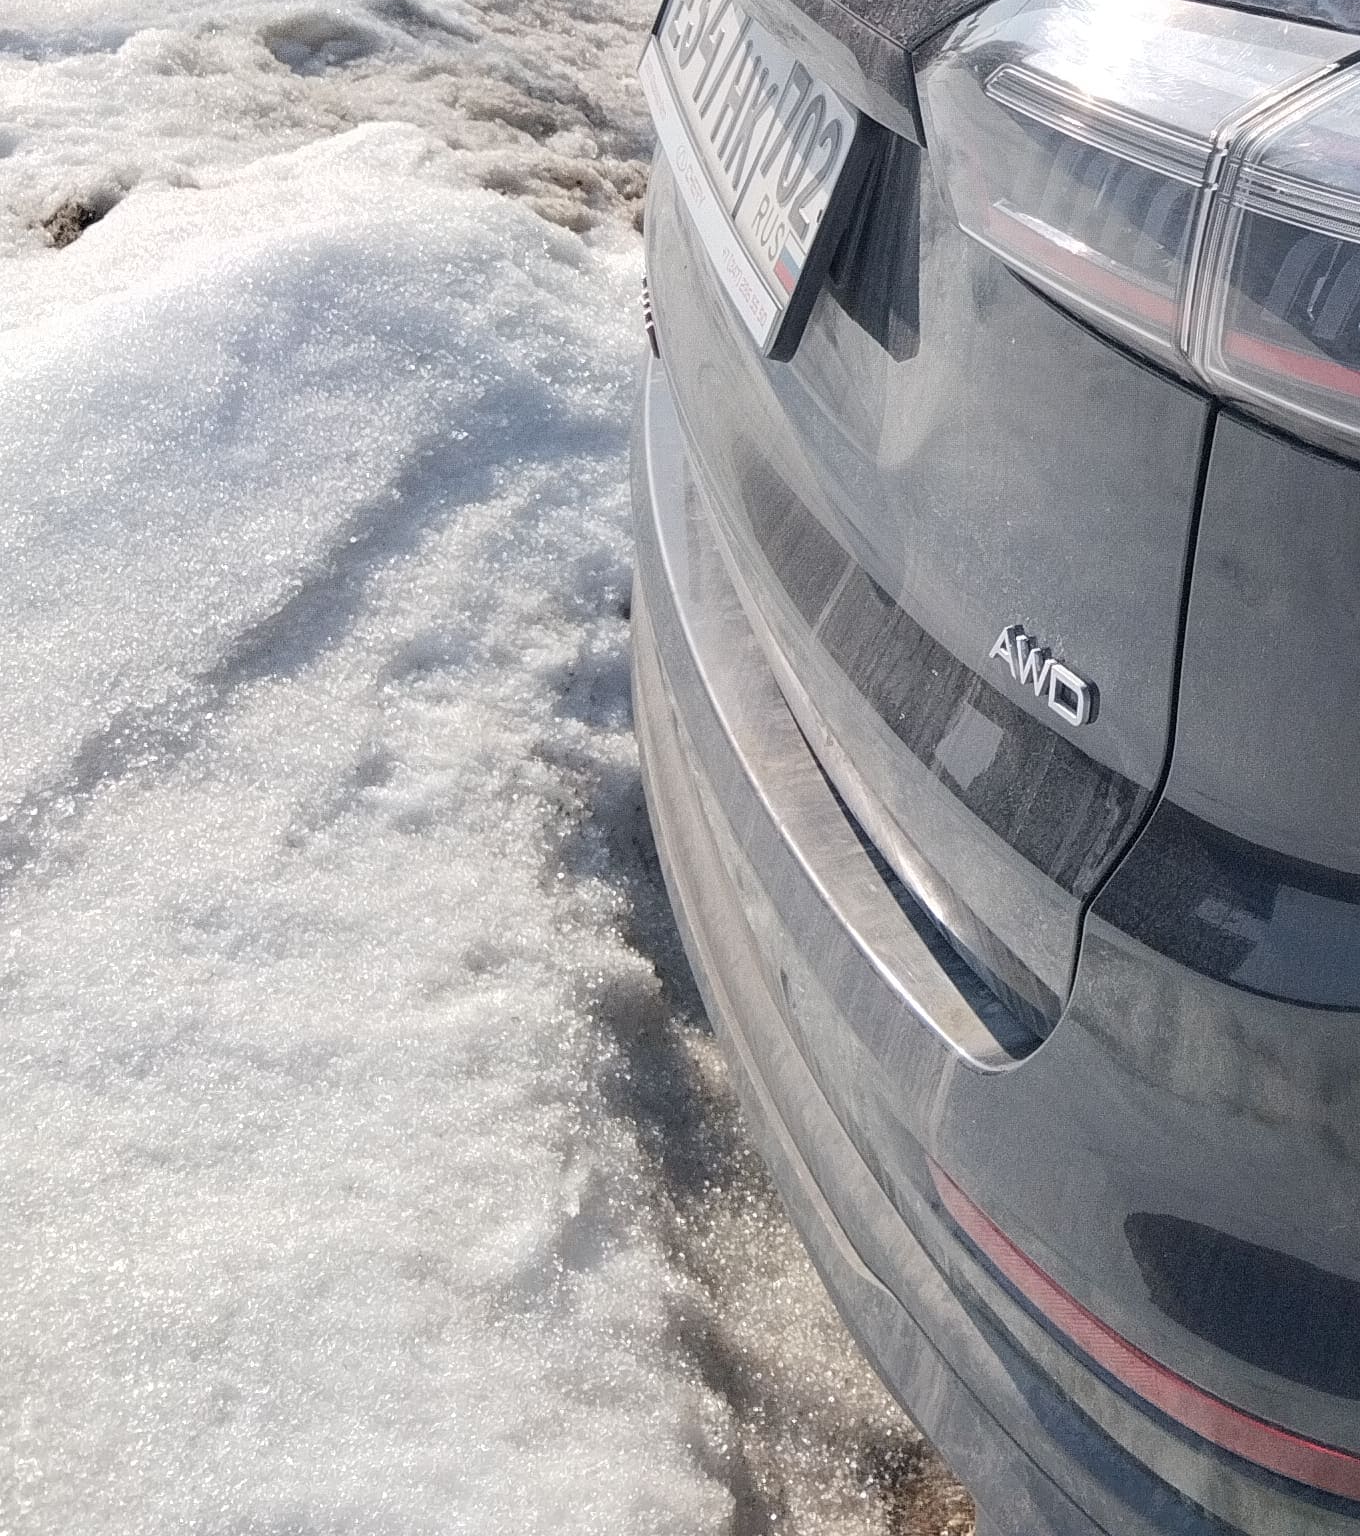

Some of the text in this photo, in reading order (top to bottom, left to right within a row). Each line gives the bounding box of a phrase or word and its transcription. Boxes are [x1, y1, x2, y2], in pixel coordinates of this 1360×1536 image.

[761, 62, 843, 242] 702
[750, 192, 786, 261] RUS
[989, 624, 1095, 727] AWD
